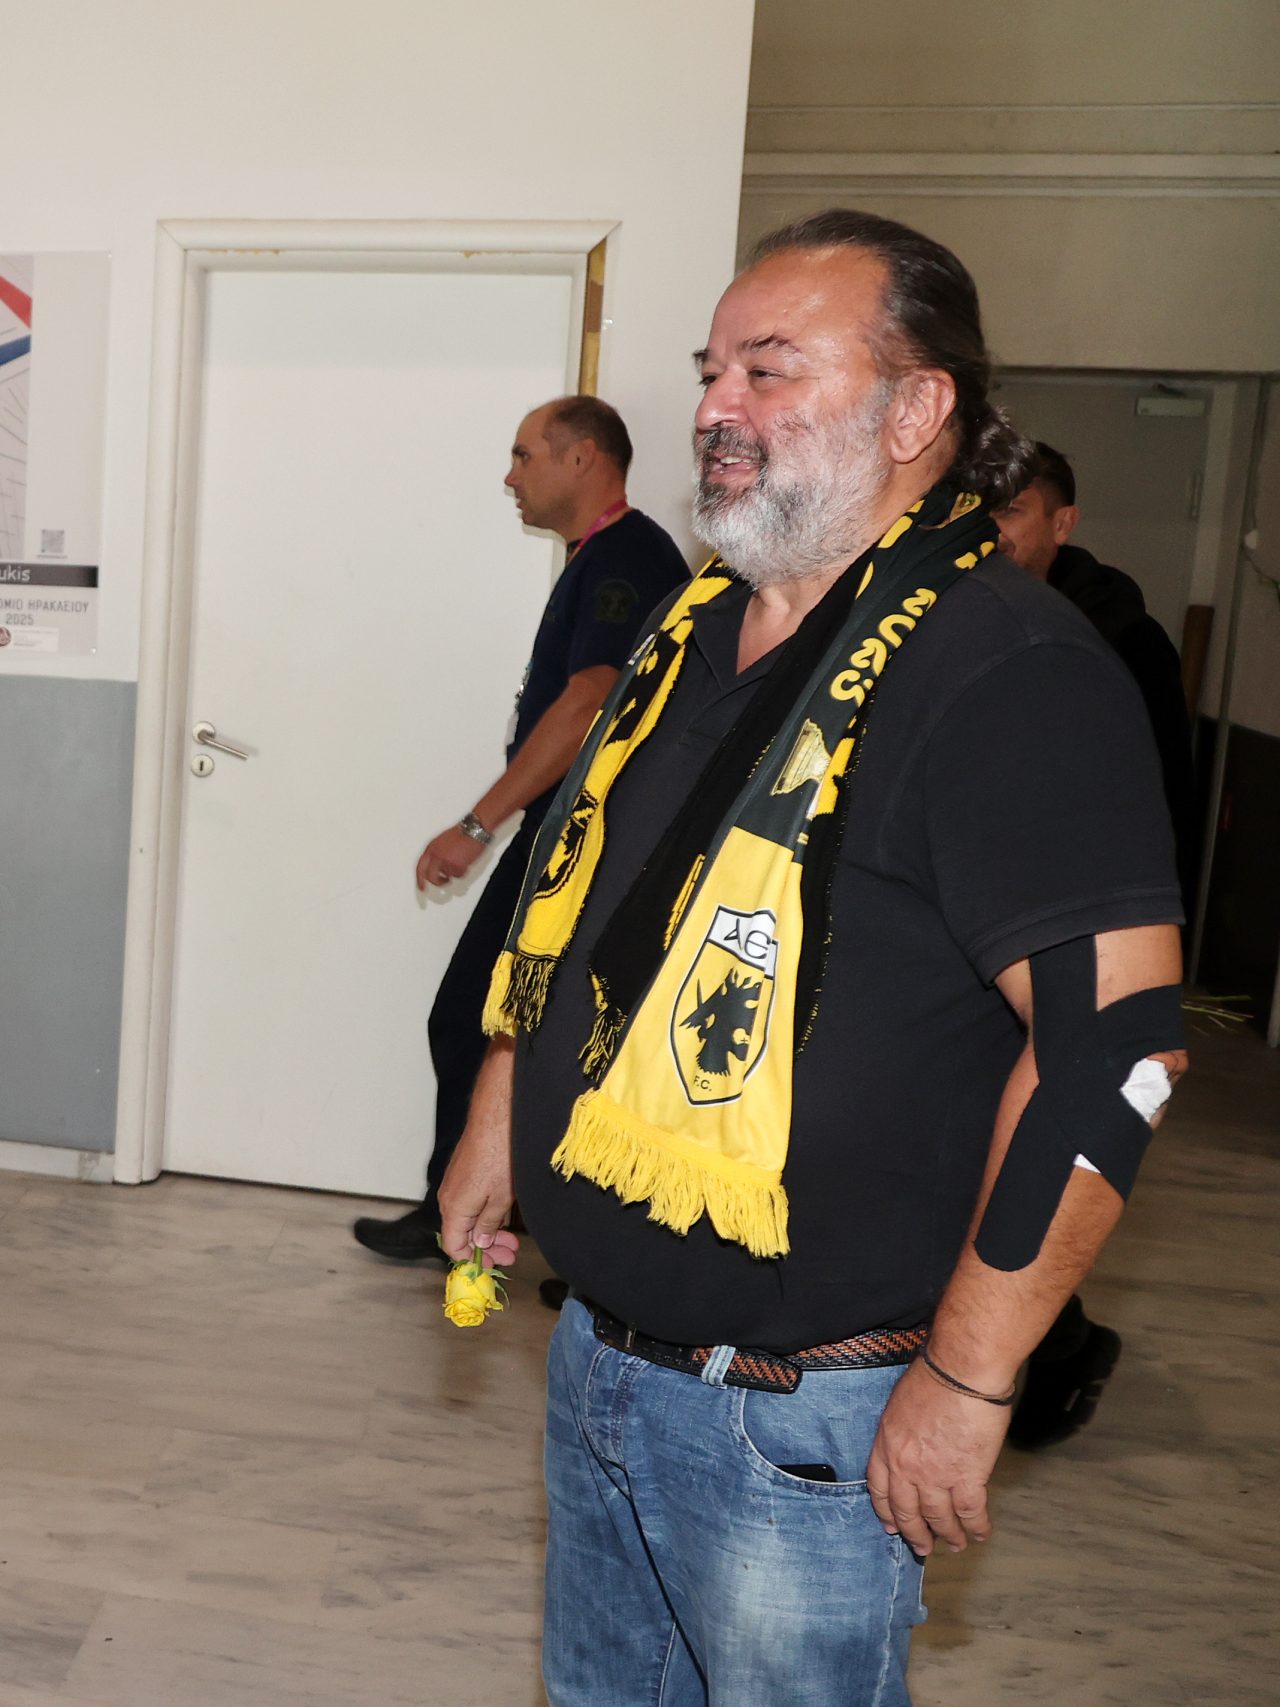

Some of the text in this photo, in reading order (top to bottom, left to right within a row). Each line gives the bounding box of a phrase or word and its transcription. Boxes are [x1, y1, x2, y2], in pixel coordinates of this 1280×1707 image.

[28, 600, 89, 613] ΗΡΑΚΛΕΙΟΥ
[5, 613, 34, 626] 2025
[693, 1075, 713, 1092] F.C.
